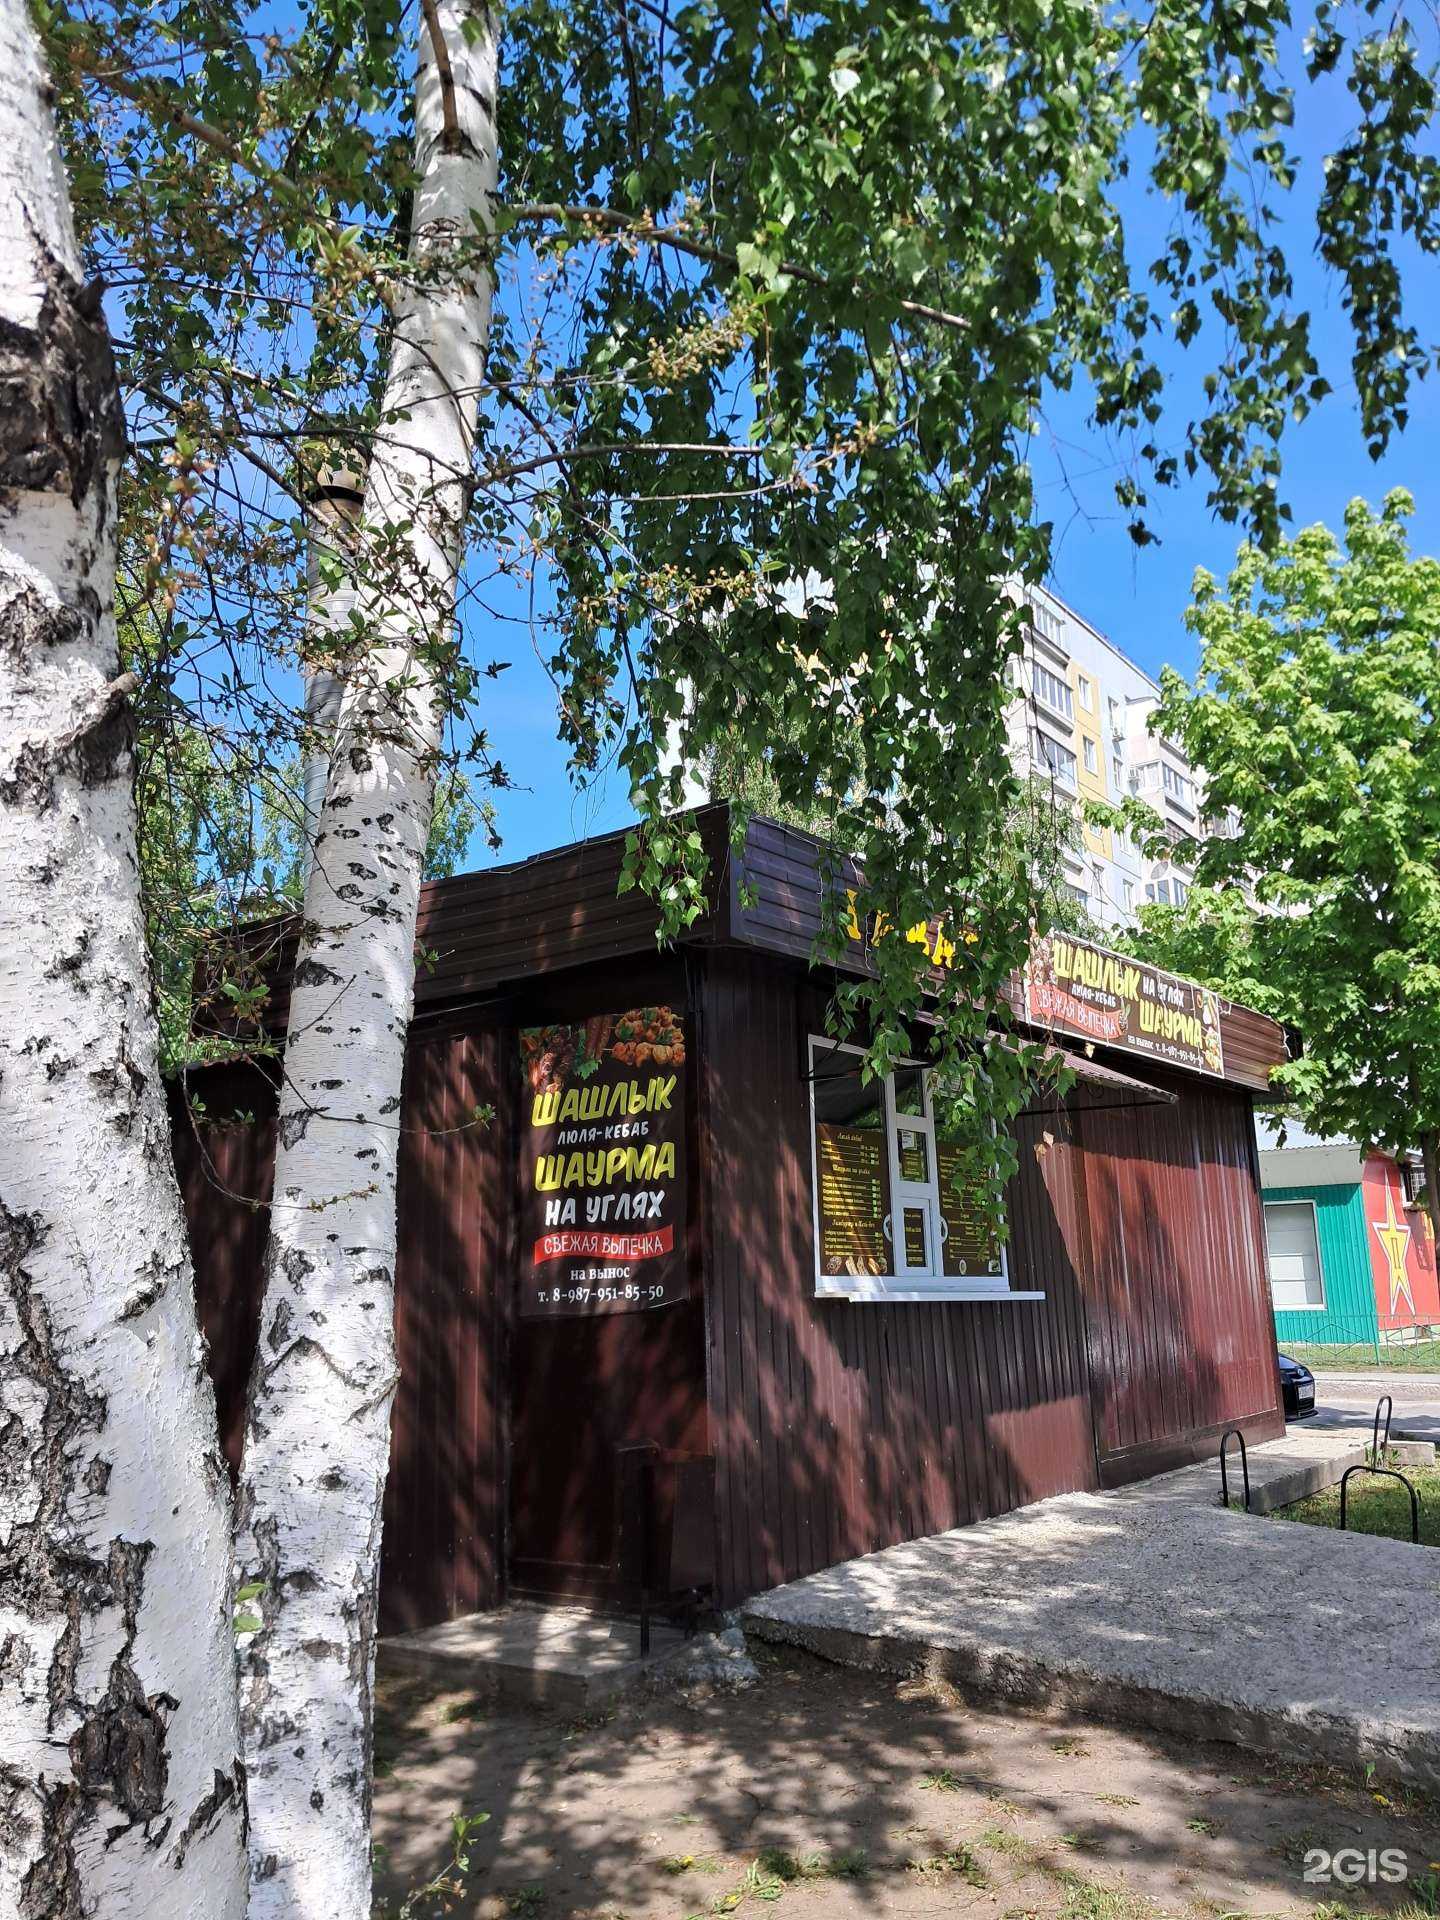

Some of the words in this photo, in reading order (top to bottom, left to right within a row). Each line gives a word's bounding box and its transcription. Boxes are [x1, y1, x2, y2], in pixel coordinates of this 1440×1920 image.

[1053, 940, 1140, 1002] ШАШЛЫК
[1143, 976, 1155, 997] НА
[1140, 999, 1203, 1049] ШАУРМА
[532, 1074, 677, 1127] ШАШЛЫК
[557, 1121, 649, 1146] ЛЮЛЯ-КЕБАБ
[535, 1141, 675, 1192] ШАУРМА
[545, 1197, 576, 1226] НА
[586, 1189, 665, 1224] УГЛЯХ
[544, 1234, 599, 1255] СВЕЖАЯ
[602, 1234, 664, 1256] ВЫПЕЧКА
[570, 1268, 586, 1281] на
[589, 1266, 630, 1280] вынос
[553, 1285, 664, 1303] 8-987-951-85-50
